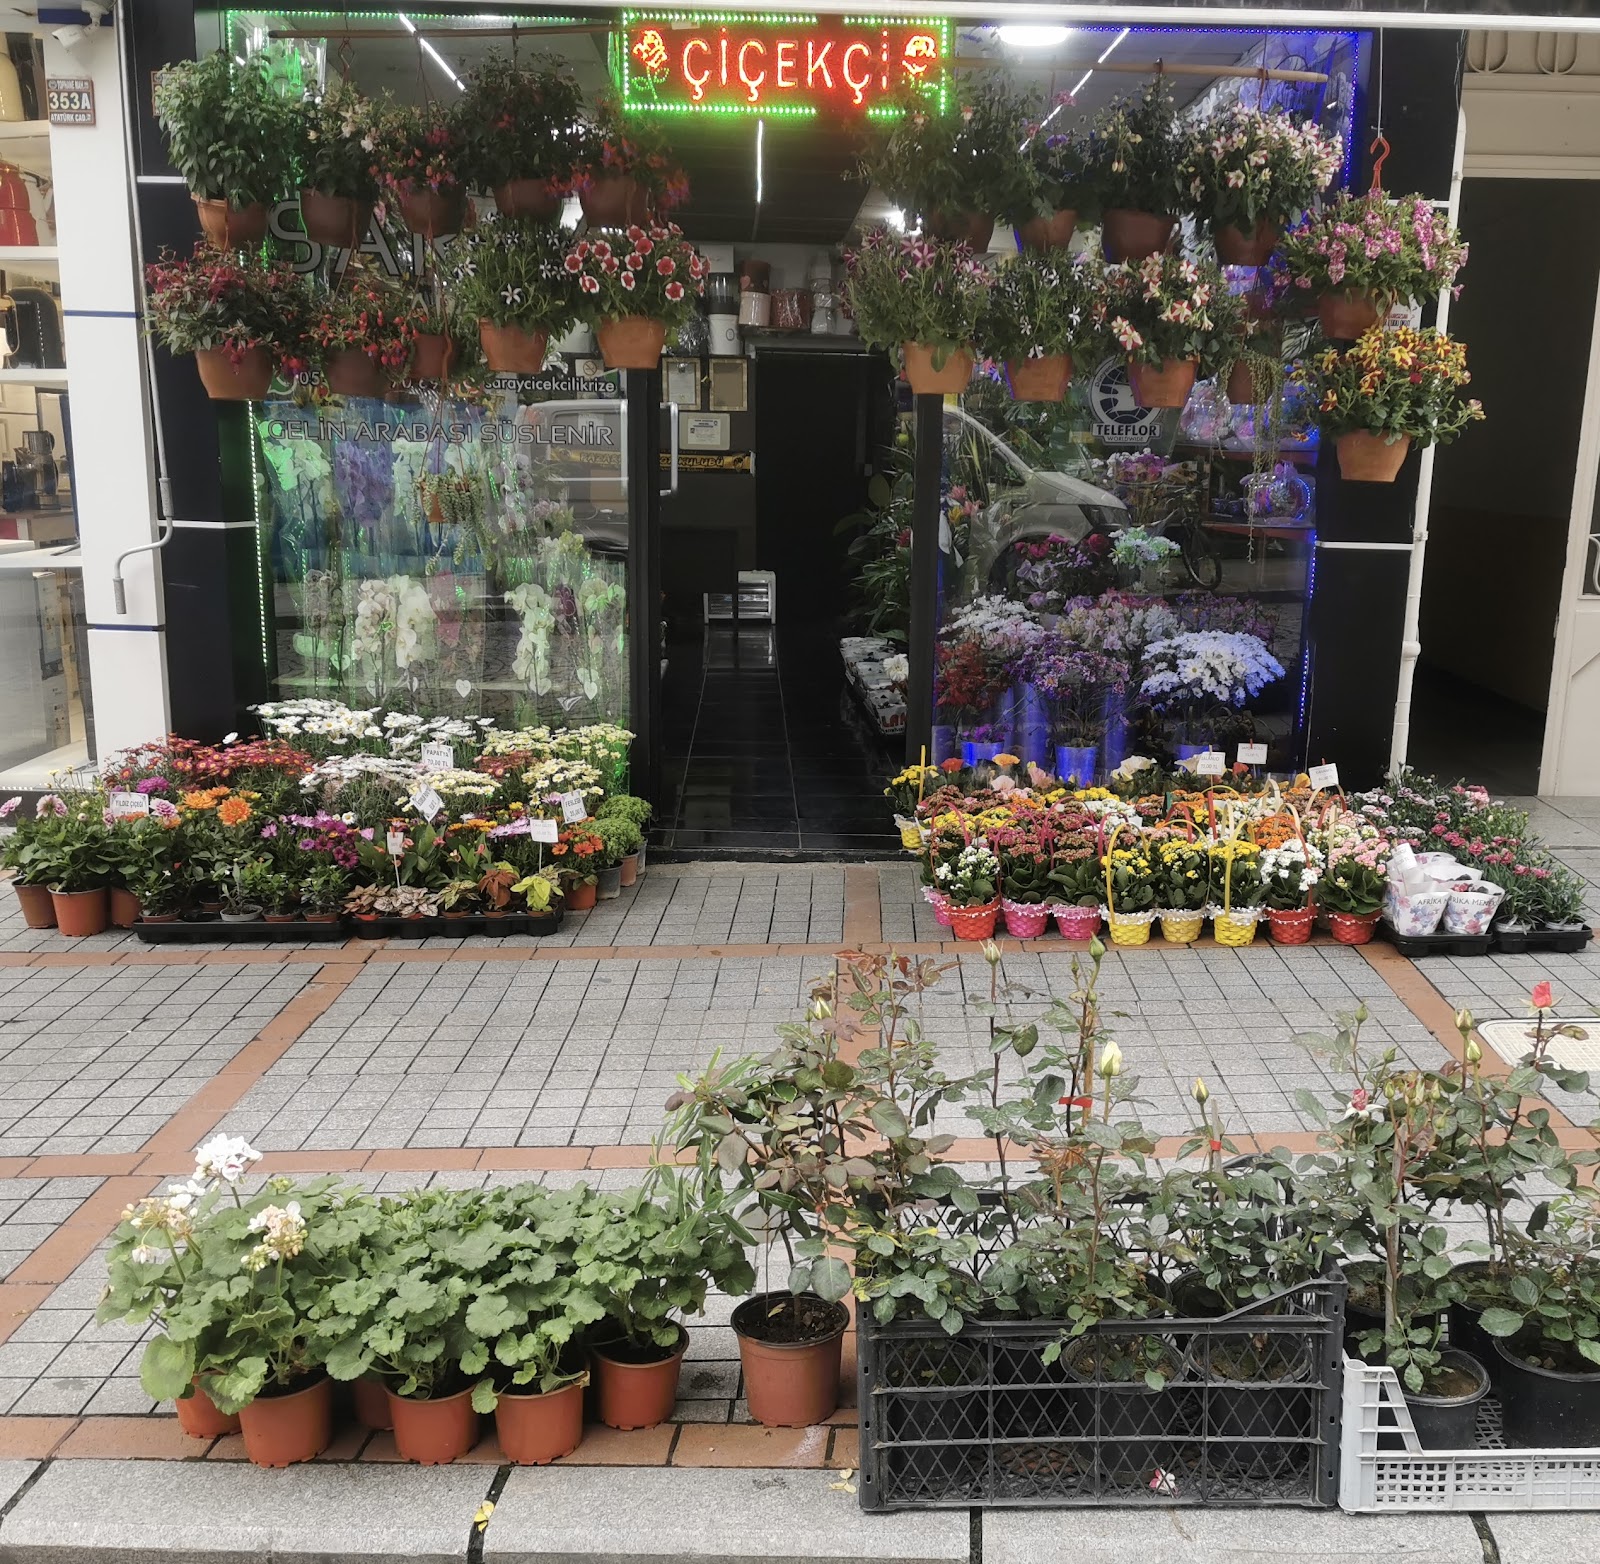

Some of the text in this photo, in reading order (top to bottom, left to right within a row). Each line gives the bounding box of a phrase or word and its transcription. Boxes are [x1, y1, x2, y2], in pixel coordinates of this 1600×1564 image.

[682, 26, 889, 105] ÇİÇEKÇİ
[49, 91, 91, 110] 353A
[51, 112, 74, 121] ATATÜRK
[268, 418, 614, 446] GELİN ARABASI SÜSLENİR
[1096, 424, 1157, 436] TELEFLOR
[426, 749, 449, 757] PAPATYA
[1417, 897, 1441, 905] AFRİKA
